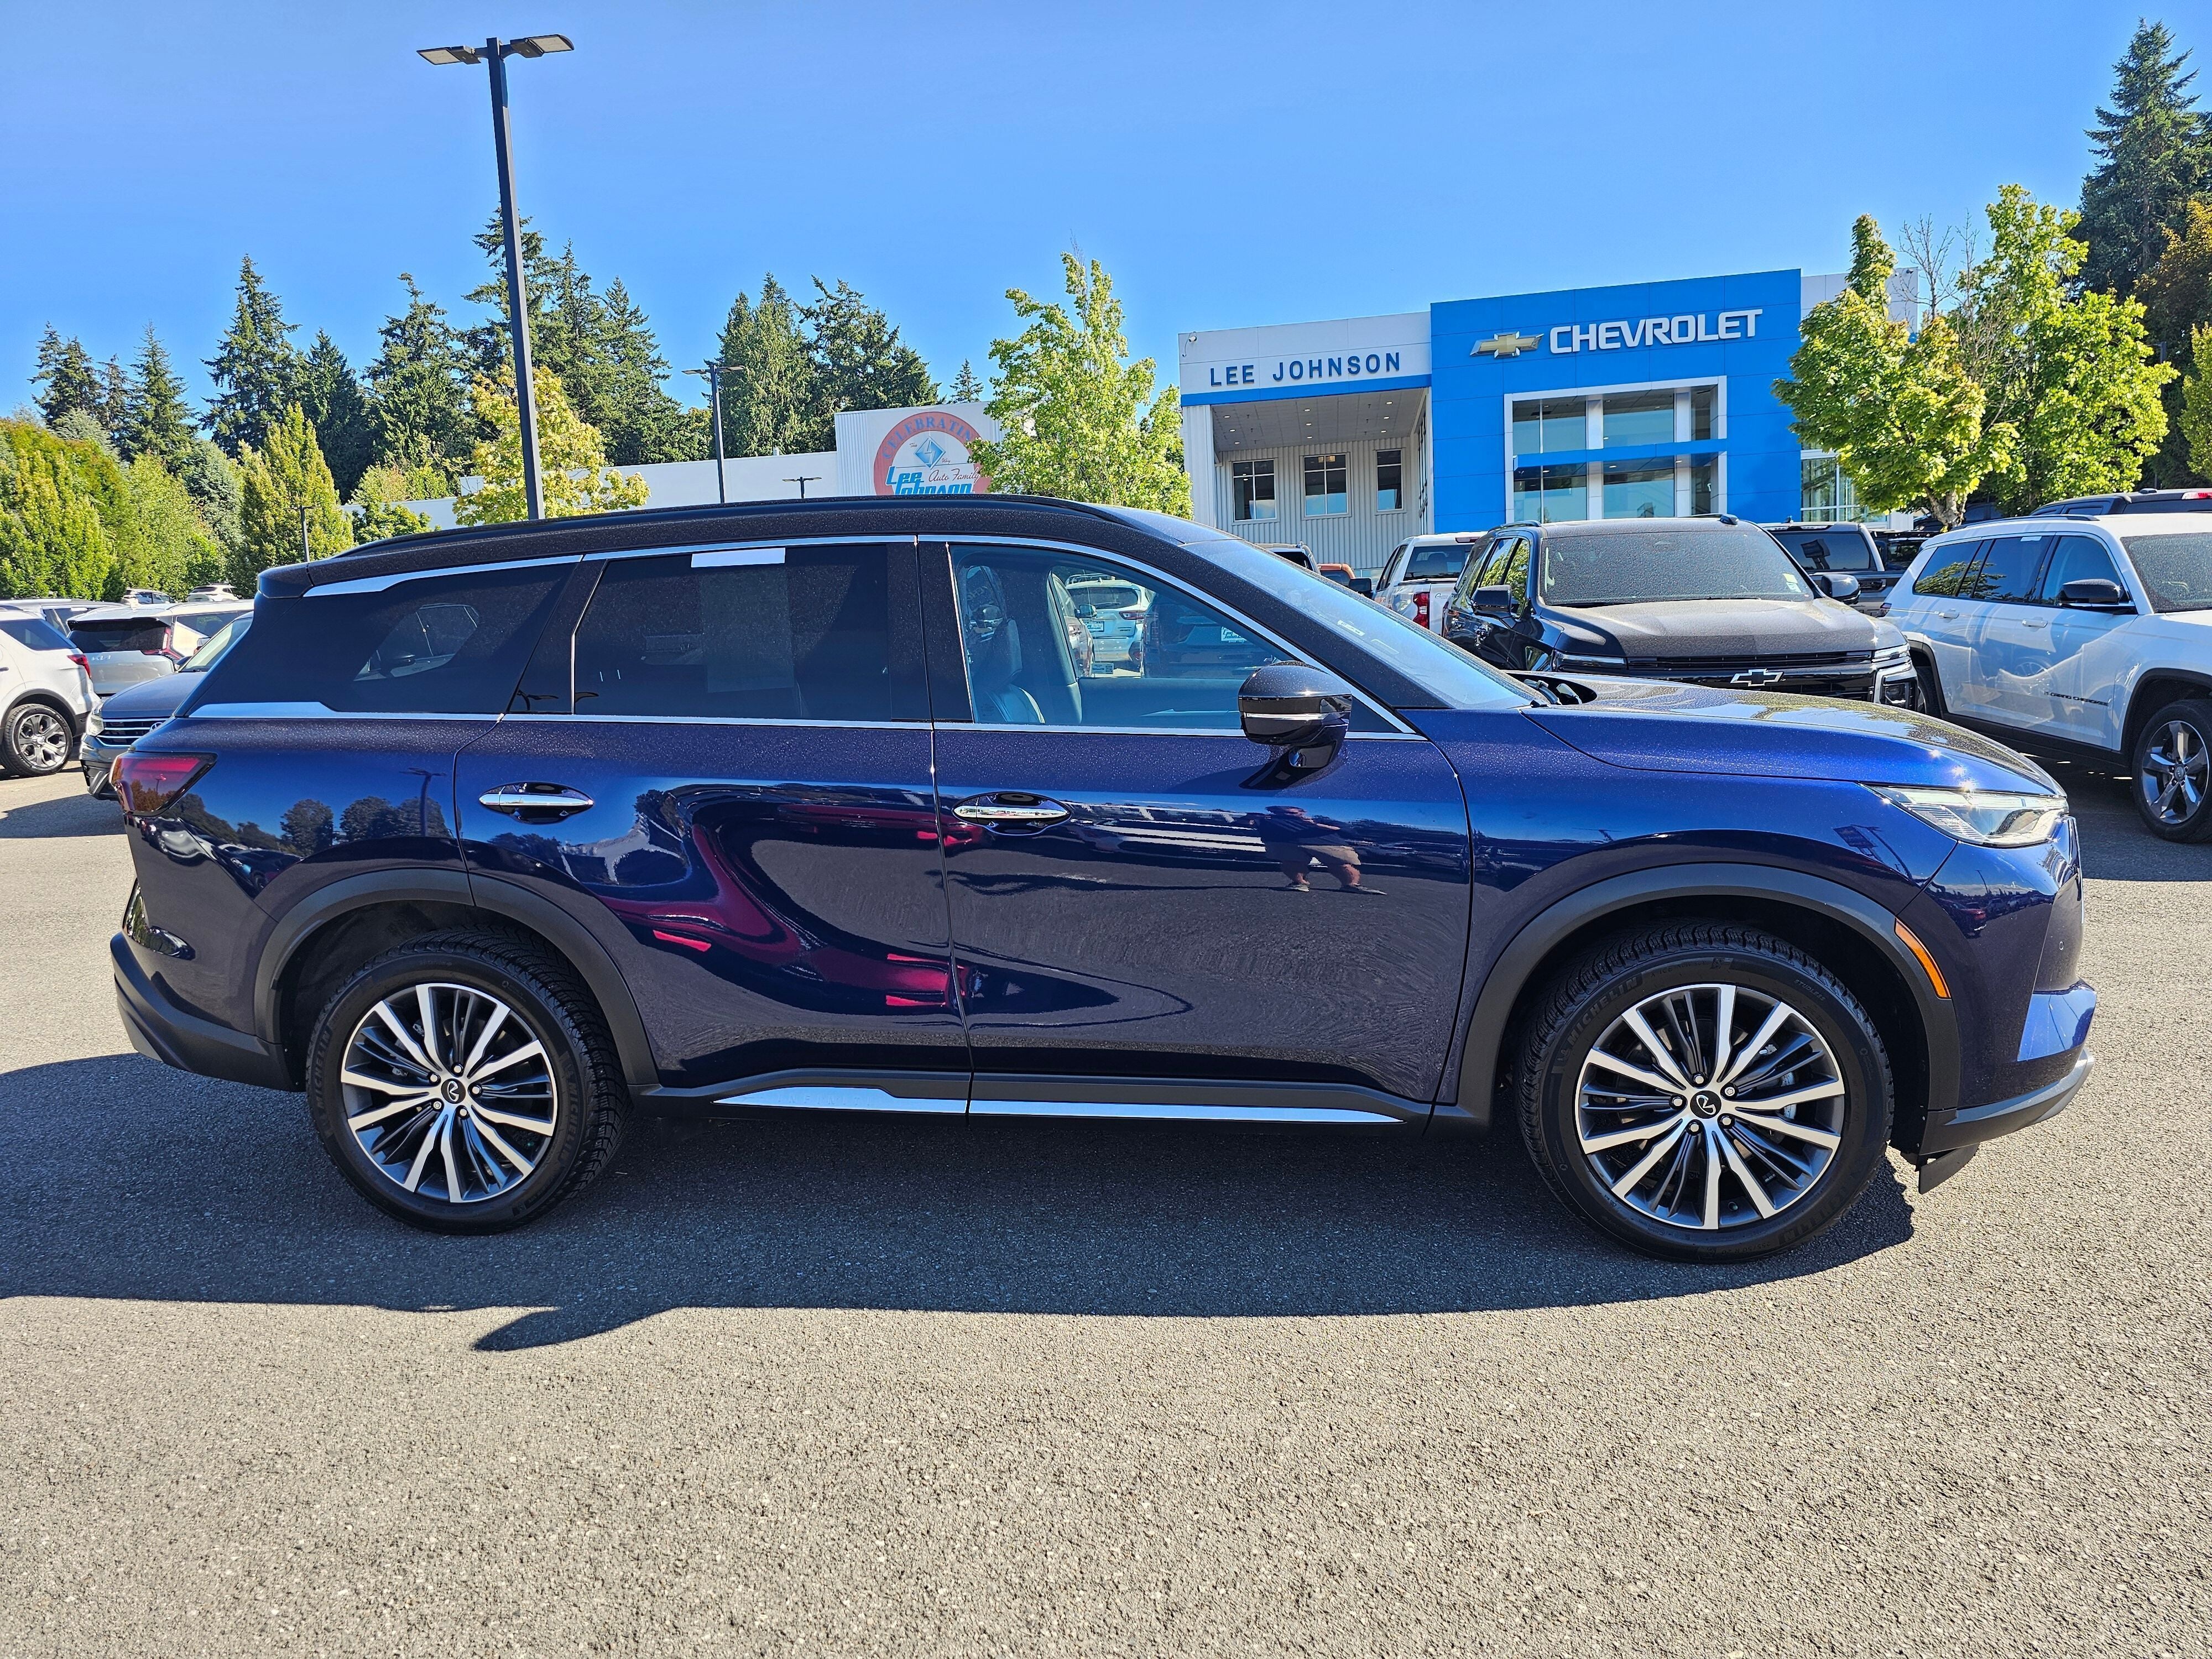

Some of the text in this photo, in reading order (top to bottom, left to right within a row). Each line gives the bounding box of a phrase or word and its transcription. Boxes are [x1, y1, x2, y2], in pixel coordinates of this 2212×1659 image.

[1550, 309, 1763, 354] CHEVROLET
[1210, 352, 1400, 387] LEE JOHNSON
[881, 415, 971, 459] CELEBRATIN
[886, 466, 924, 484] Lee
[928, 467, 980, 483] Auto Family
[1567, 977, 1637, 1046] MICHELIN
[1795, 979, 1826, 1001] STUDLESS
[314, 1030, 331, 1110] MICHELIN
[560, 1082, 578, 1160] MICHELIN
